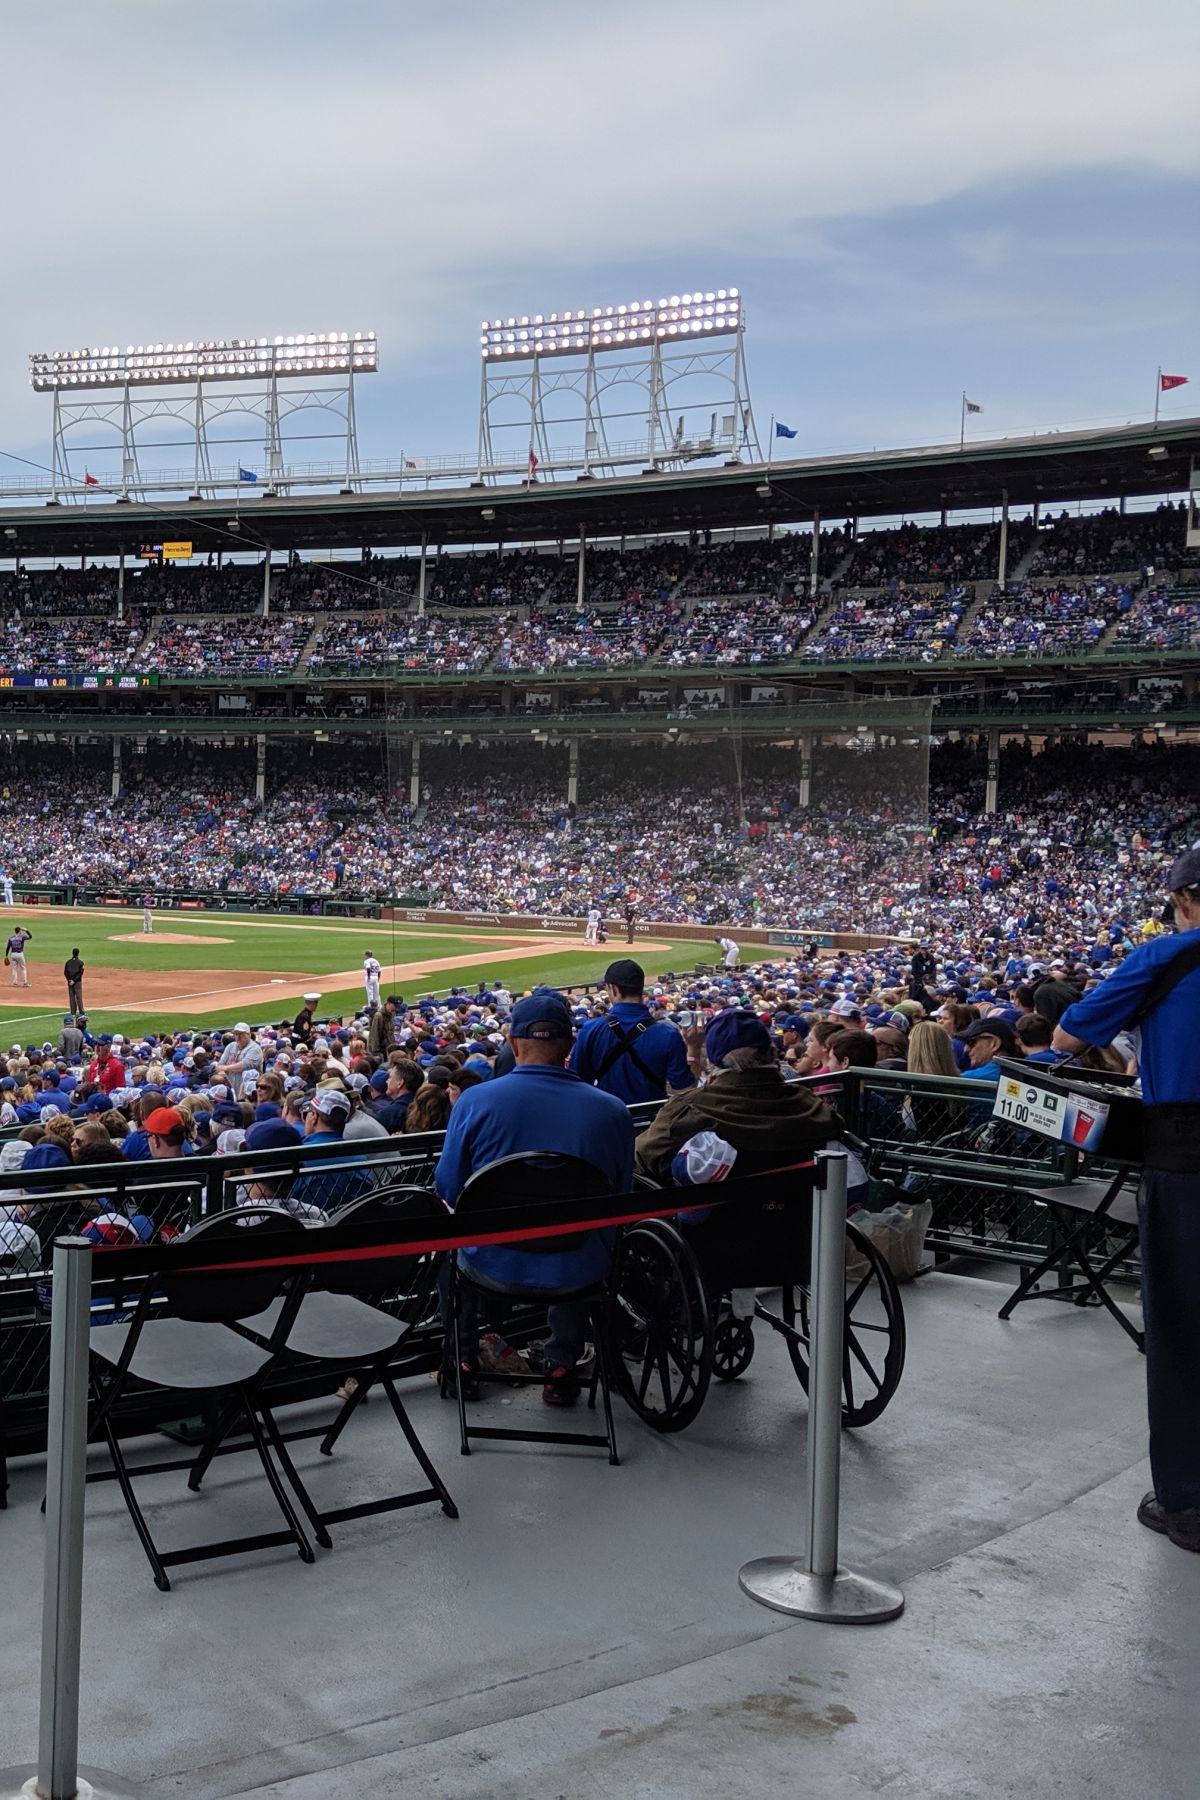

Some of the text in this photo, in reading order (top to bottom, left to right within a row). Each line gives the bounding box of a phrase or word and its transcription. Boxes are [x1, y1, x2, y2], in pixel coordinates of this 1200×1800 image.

[34, 679, 48, 687] ERA
[52, 679, 66, 687] 0.00
[784, 934, 824, 942] DYNGY
[1001, 1099, 1029, 1122] 11.00
